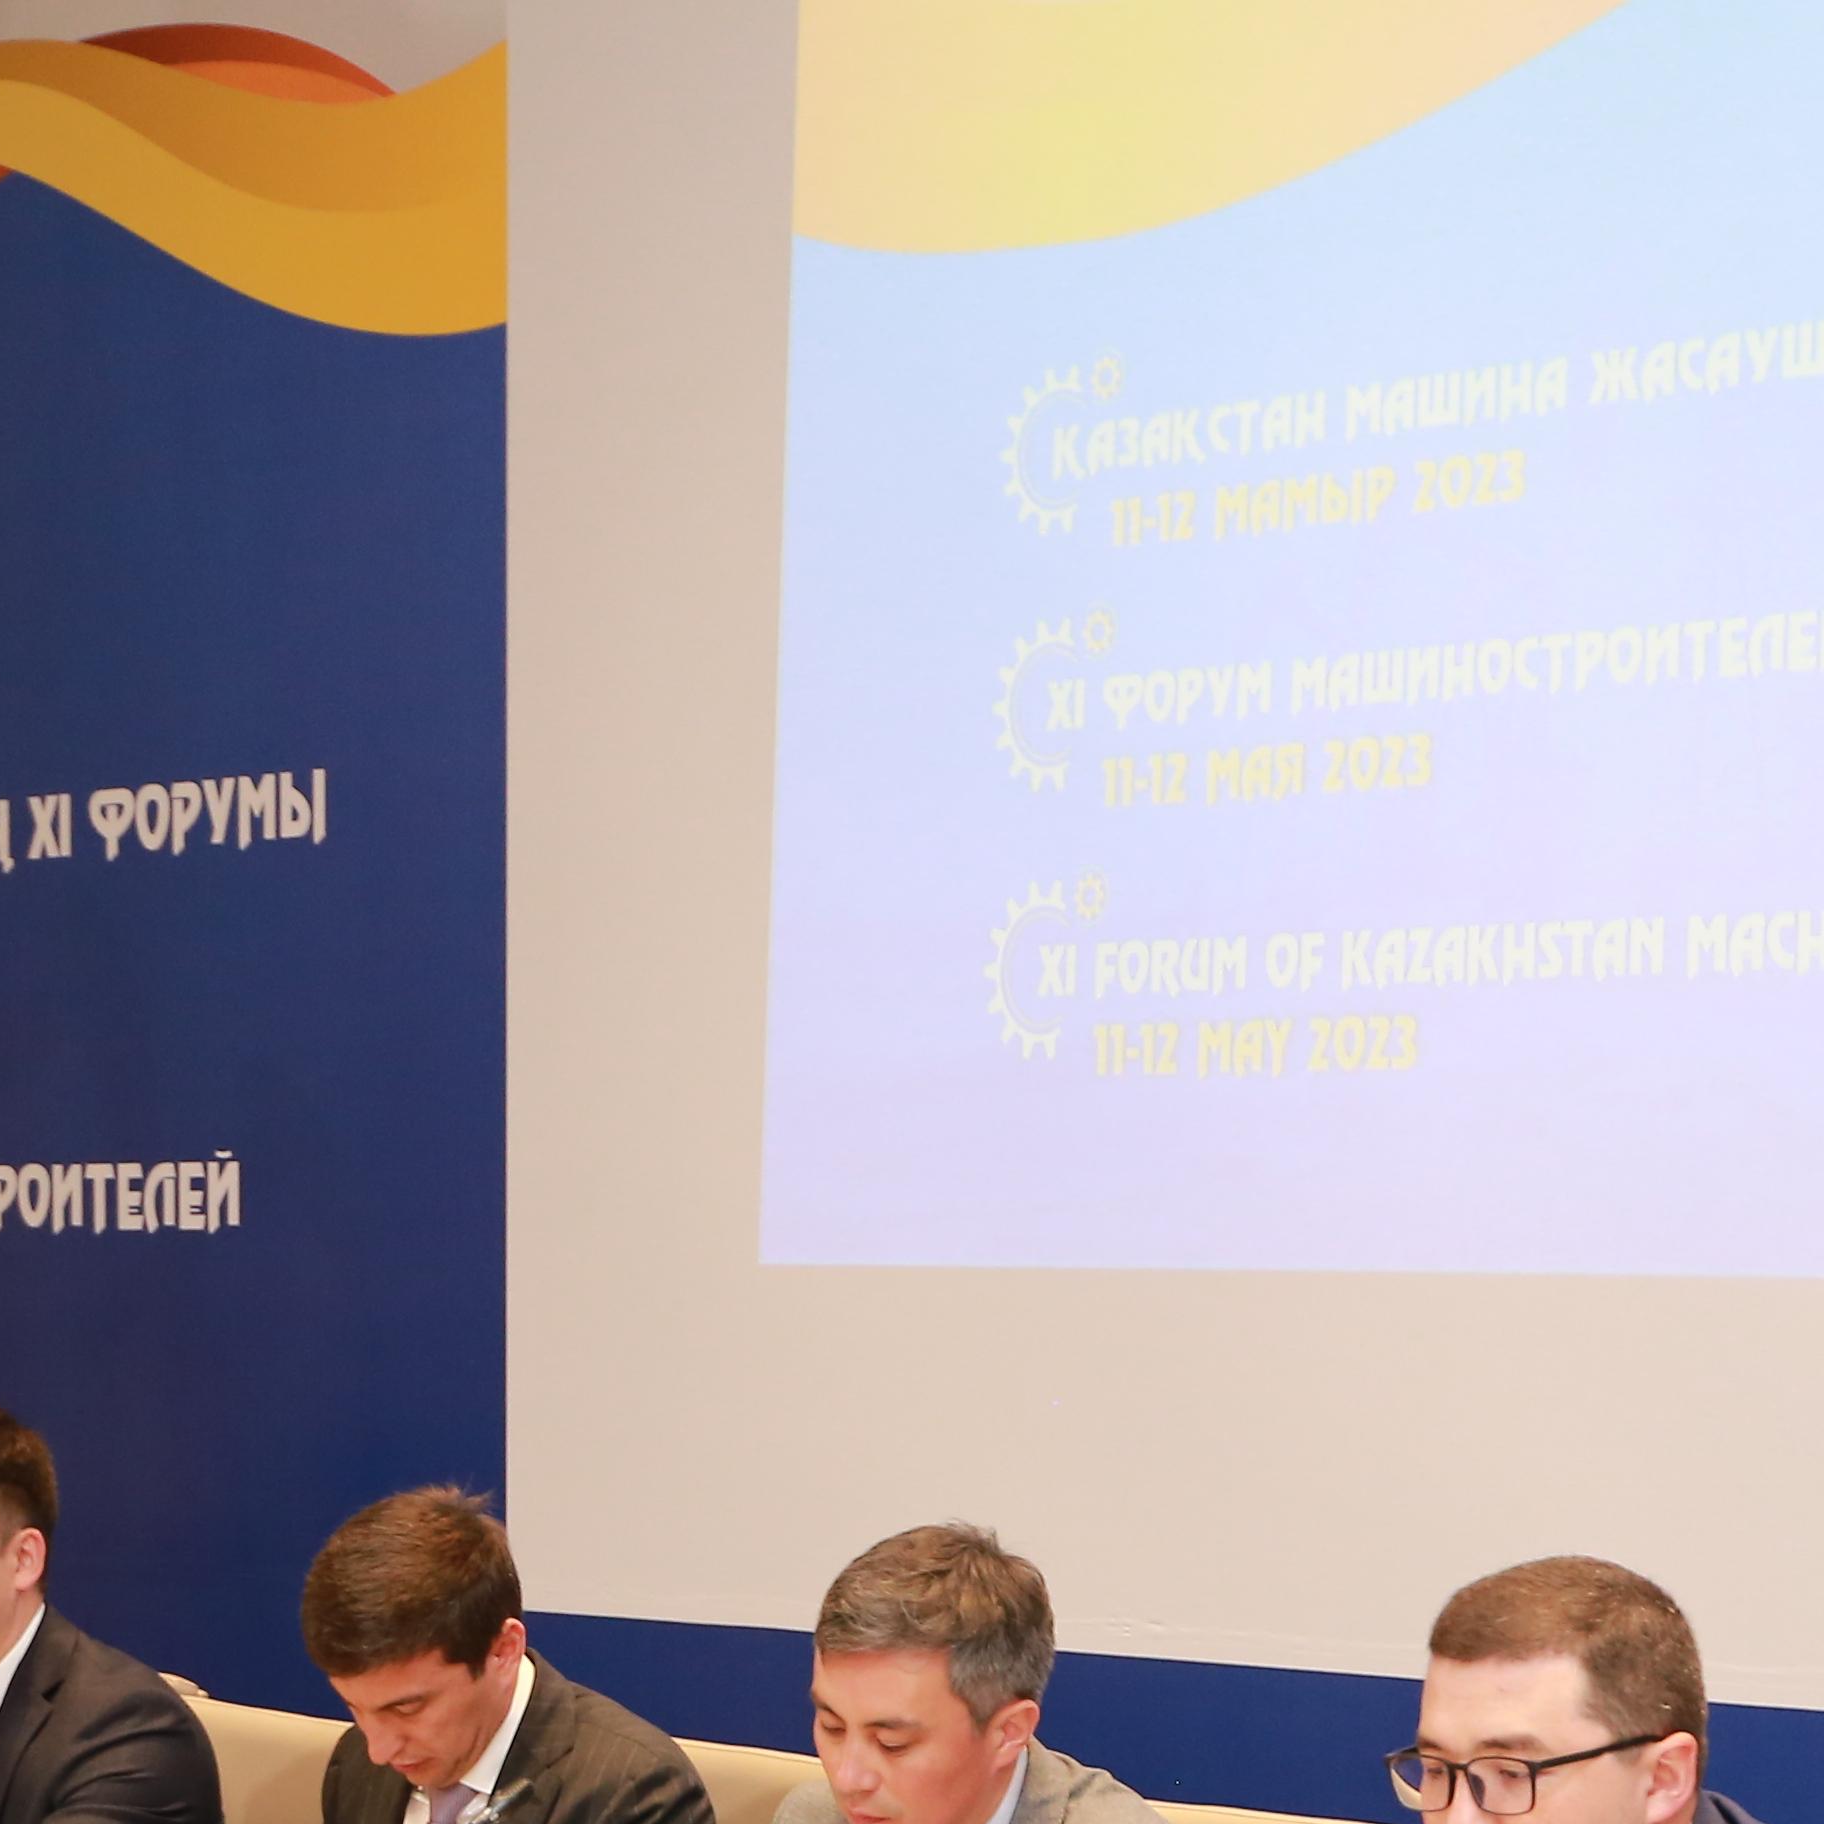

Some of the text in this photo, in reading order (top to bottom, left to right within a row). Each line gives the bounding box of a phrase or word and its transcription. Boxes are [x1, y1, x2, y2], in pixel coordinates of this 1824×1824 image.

[1051, 391, 1326, 481] ҚАЗАҚСТАН
[1346, 356, 1569, 443] МАШИНА
[1111, 450, 1526, 546] 11-12 МАМЫР 2023
[1101, 660, 1272, 730] ФОРУМ
[1101, 732, 1433, 807] 11-12 МАЯ 2023
[89, 768, 325, 860] ФОРУМЫ
[1037, 944, 1075, 998] XI
[1094, 932, 1246, 999] FORUM
[1265, 932, 1324, 992] OF
[1341, 915, 1664, 990] KAZAKHSTAN
[1094, 1013, 1419, 1079] 11-12 MAY 2023
